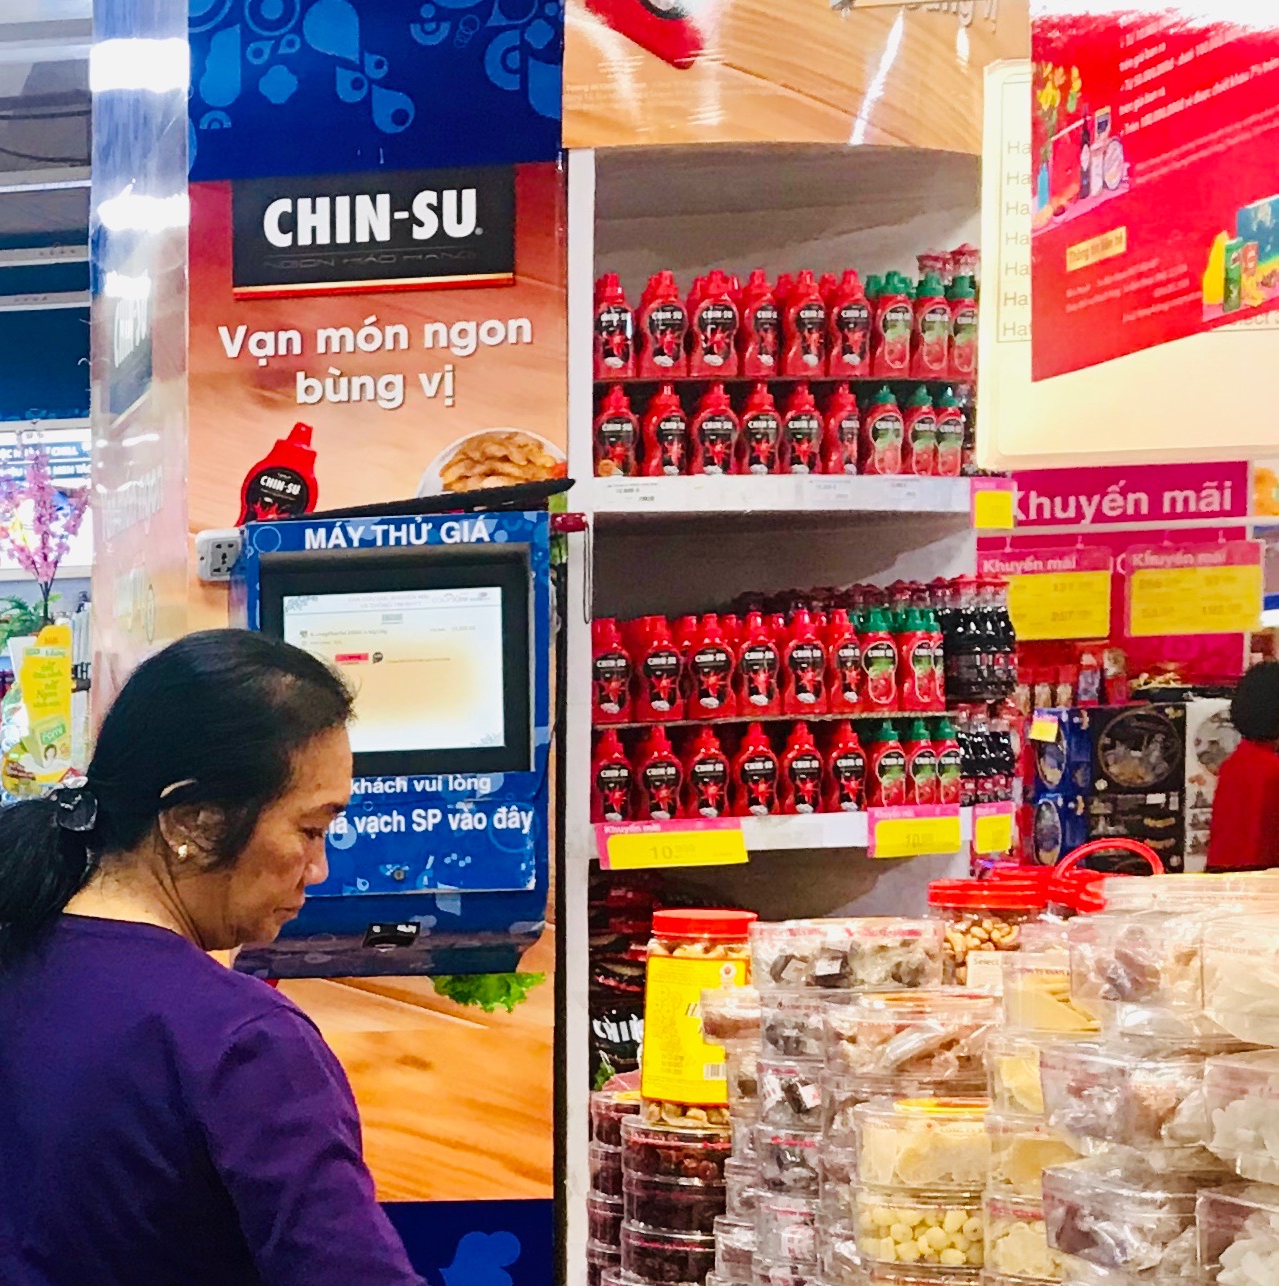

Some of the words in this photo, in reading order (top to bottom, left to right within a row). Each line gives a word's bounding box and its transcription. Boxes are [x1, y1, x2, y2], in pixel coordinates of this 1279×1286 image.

[262, 188, 477, 248] CHIN-SU
[218, 325, 302, 367] Vạn
[317, 315, 408, 354] món
[424, 317, 532, 357] ngon
[296, 366, 405, 410] bùng
[419, 364, 454, 407] vị
[260, 474, 301, 496] CHIN-SU
[1162, 480, 1232, 514] mãi
[304, 522, 373, 550] MÁY
[374, 515, 432, 546] THỬ
[440, 517, 491, 542] GIÁ
[983, 557, 1043, 574] Khuyến
[1047, 556, 1077, 571] mãi
[351, 777, 407, 795] khách
[413, 775, 442, 792] vui
[448, 775, 492, 797] lòng
[353, 810, 405, 839] vạch
[412, 808, 442, 832] SP
[447, 807, 487, 831] vào
[493, 805, 534, 834] đây
